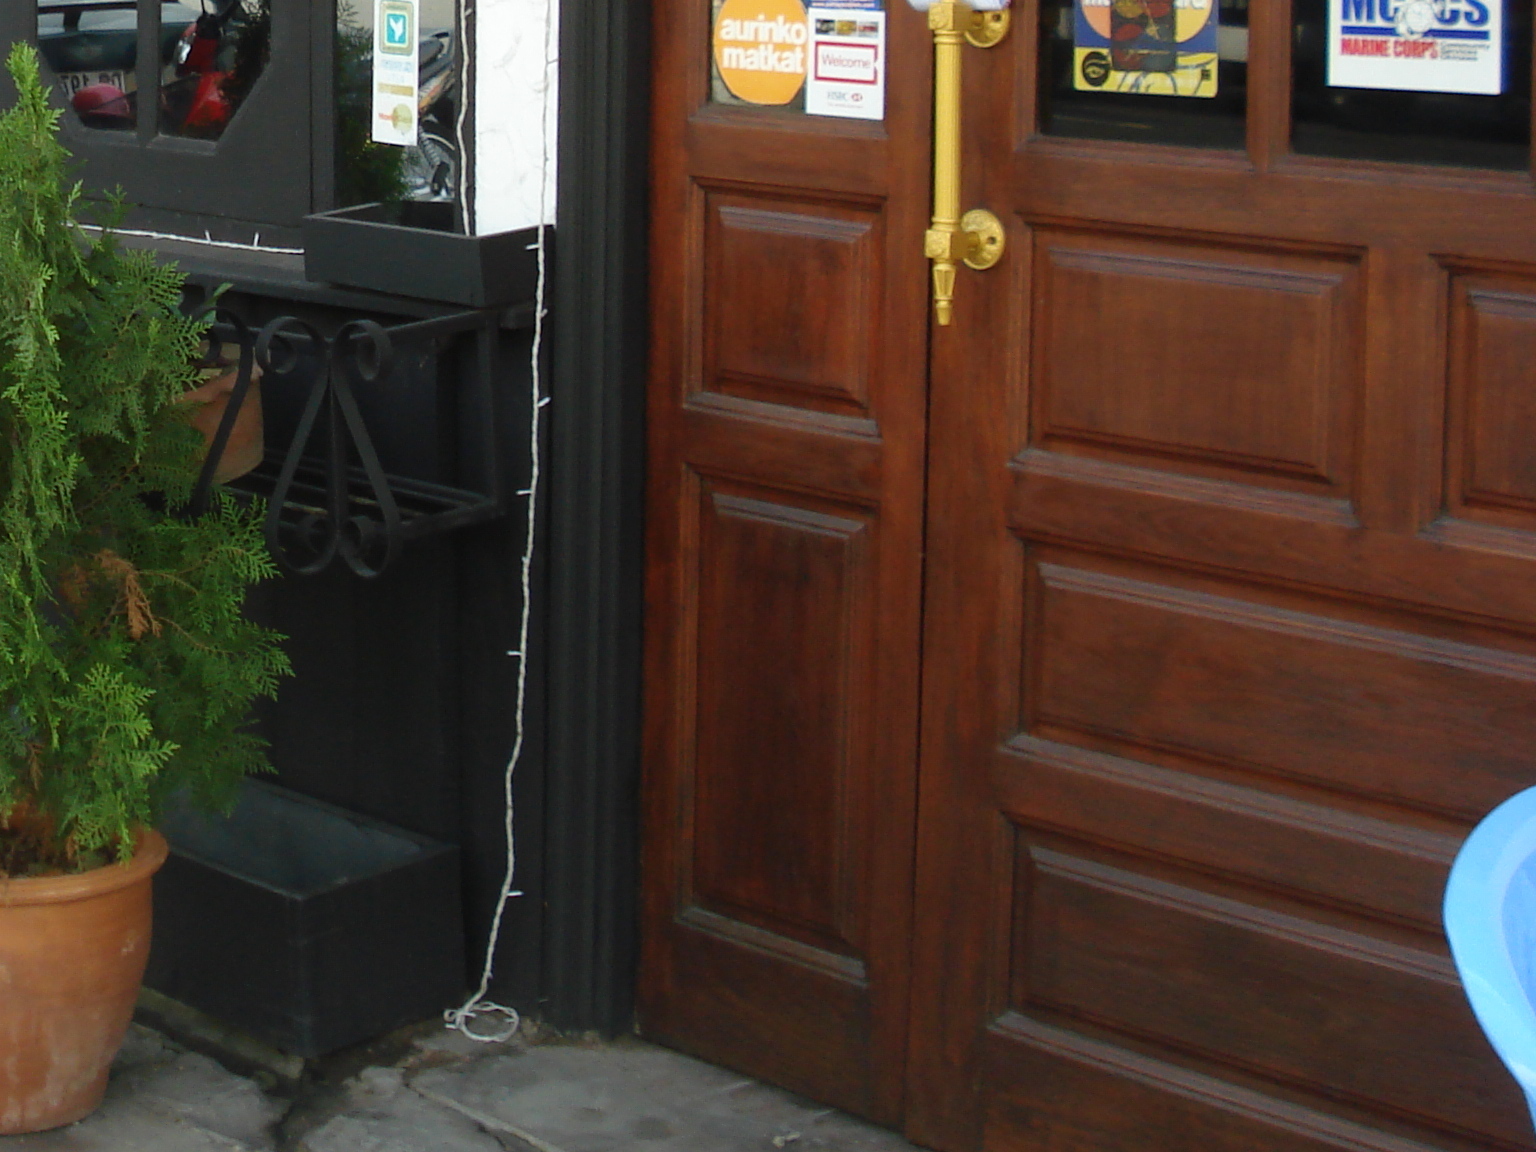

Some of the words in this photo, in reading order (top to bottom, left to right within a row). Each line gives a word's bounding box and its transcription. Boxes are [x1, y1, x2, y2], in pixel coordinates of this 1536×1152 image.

[720, 14, 807, 45] aurinko
[722, 44, 804, 74] matkat
[822, 53, 872, 69] Welcome
[1340, 38, 1390, 57] MARINE
[1393, 39, 1439, 59] CORPS
